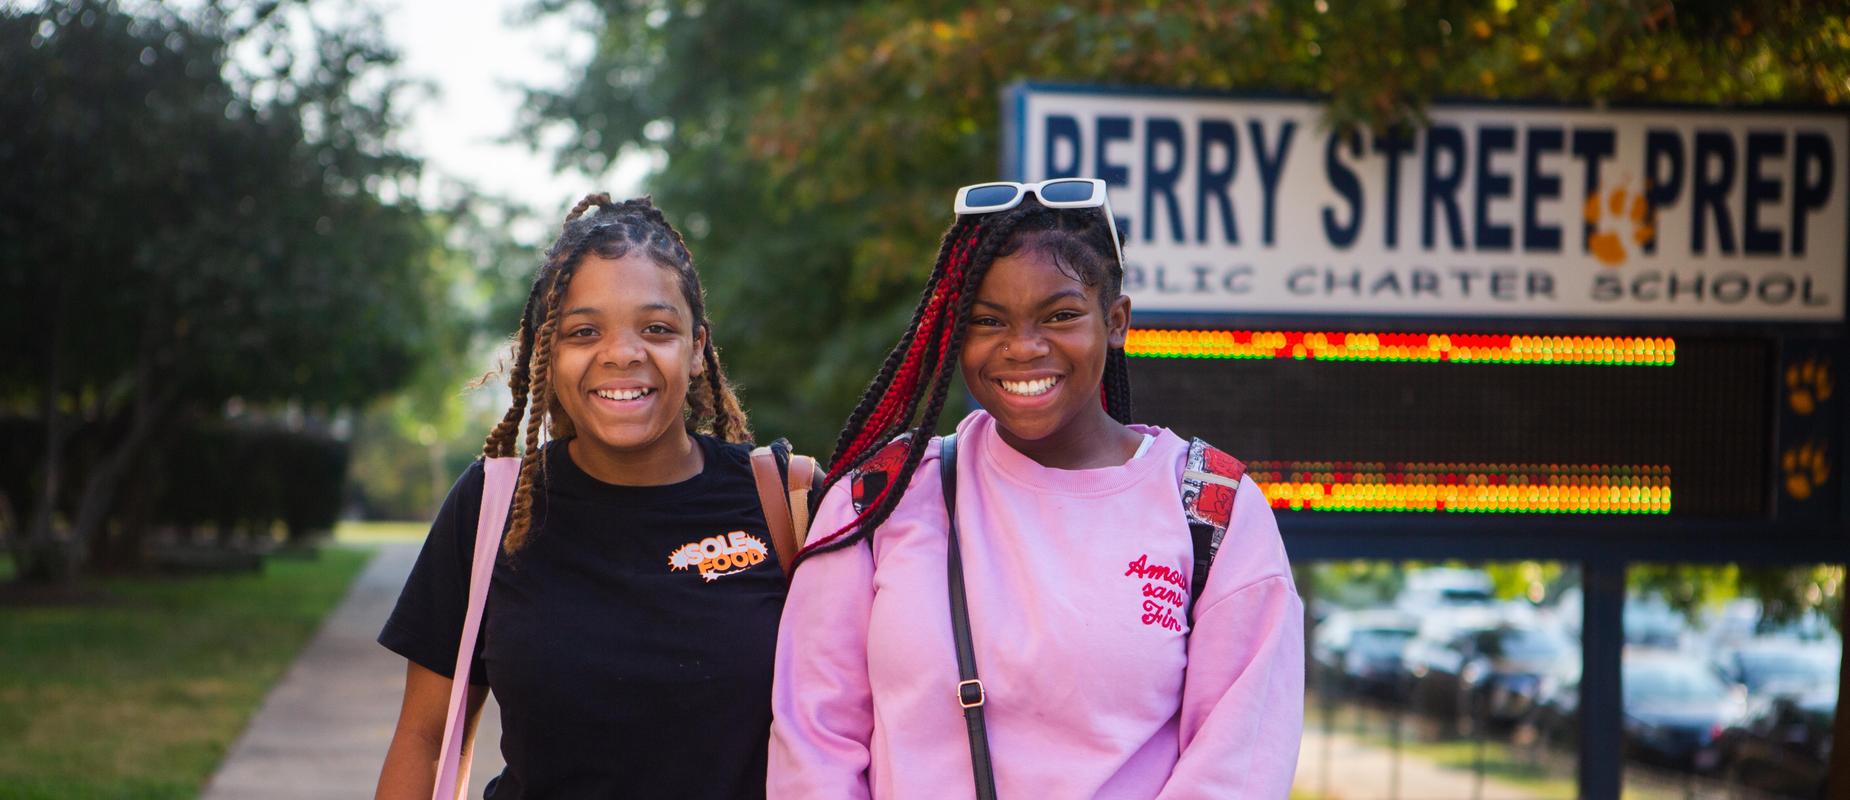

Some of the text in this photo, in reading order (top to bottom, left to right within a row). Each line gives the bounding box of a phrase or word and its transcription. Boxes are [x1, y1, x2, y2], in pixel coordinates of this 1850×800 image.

[1322, 120, 1617, 252] STREET
[1642, 129, 1836, 257] PREP
[1122, 264, 1831, 306] BLIC CHARTER SCHOOL
[684, 531, 749, 565] SOLE
[698, 549, 764, 575] FOOD
[1142, 582, 1184, 608] sans
[1141, 599, 1182, 632] Fin
